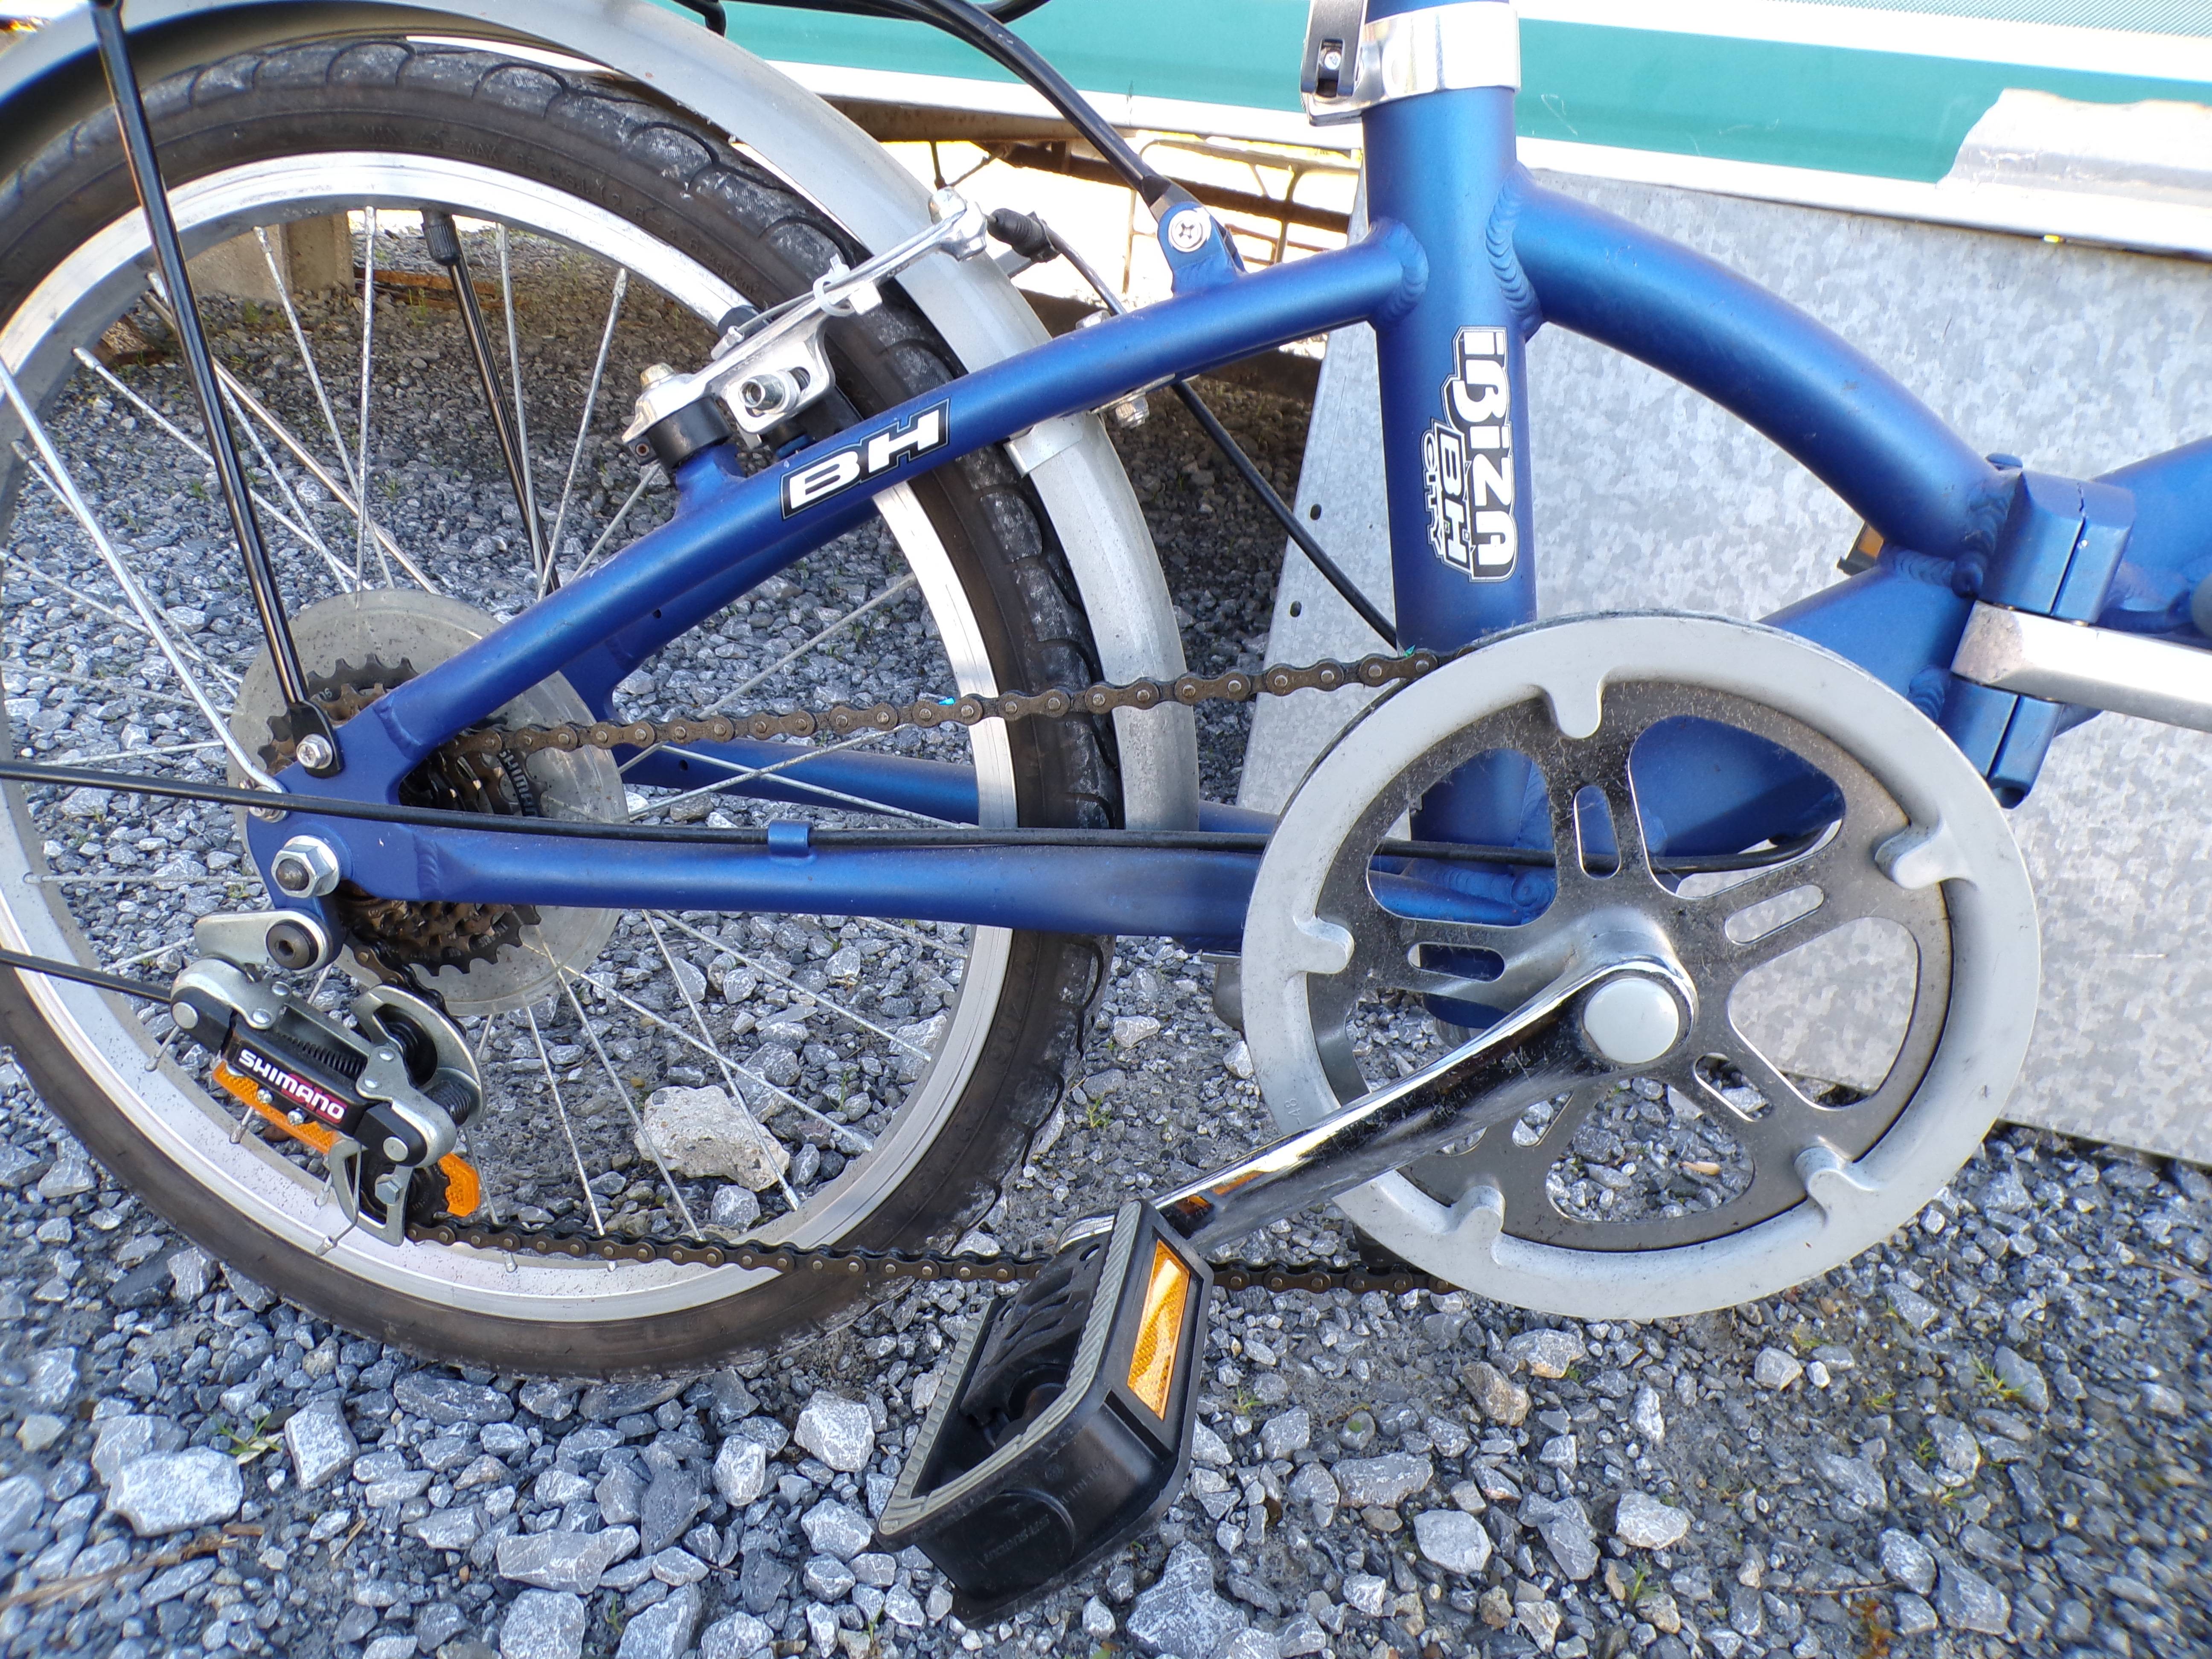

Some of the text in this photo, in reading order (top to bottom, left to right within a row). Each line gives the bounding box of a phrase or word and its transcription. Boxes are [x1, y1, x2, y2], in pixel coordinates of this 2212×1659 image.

[789, 409, 939, 509] BH
[1424, 431, 1445, 556] CITY
[1440, 433, 1467, 563] BH
[499, 749, 536, 816] SHIMAN
[239, 1049, 345, 1120] SHIMANO
